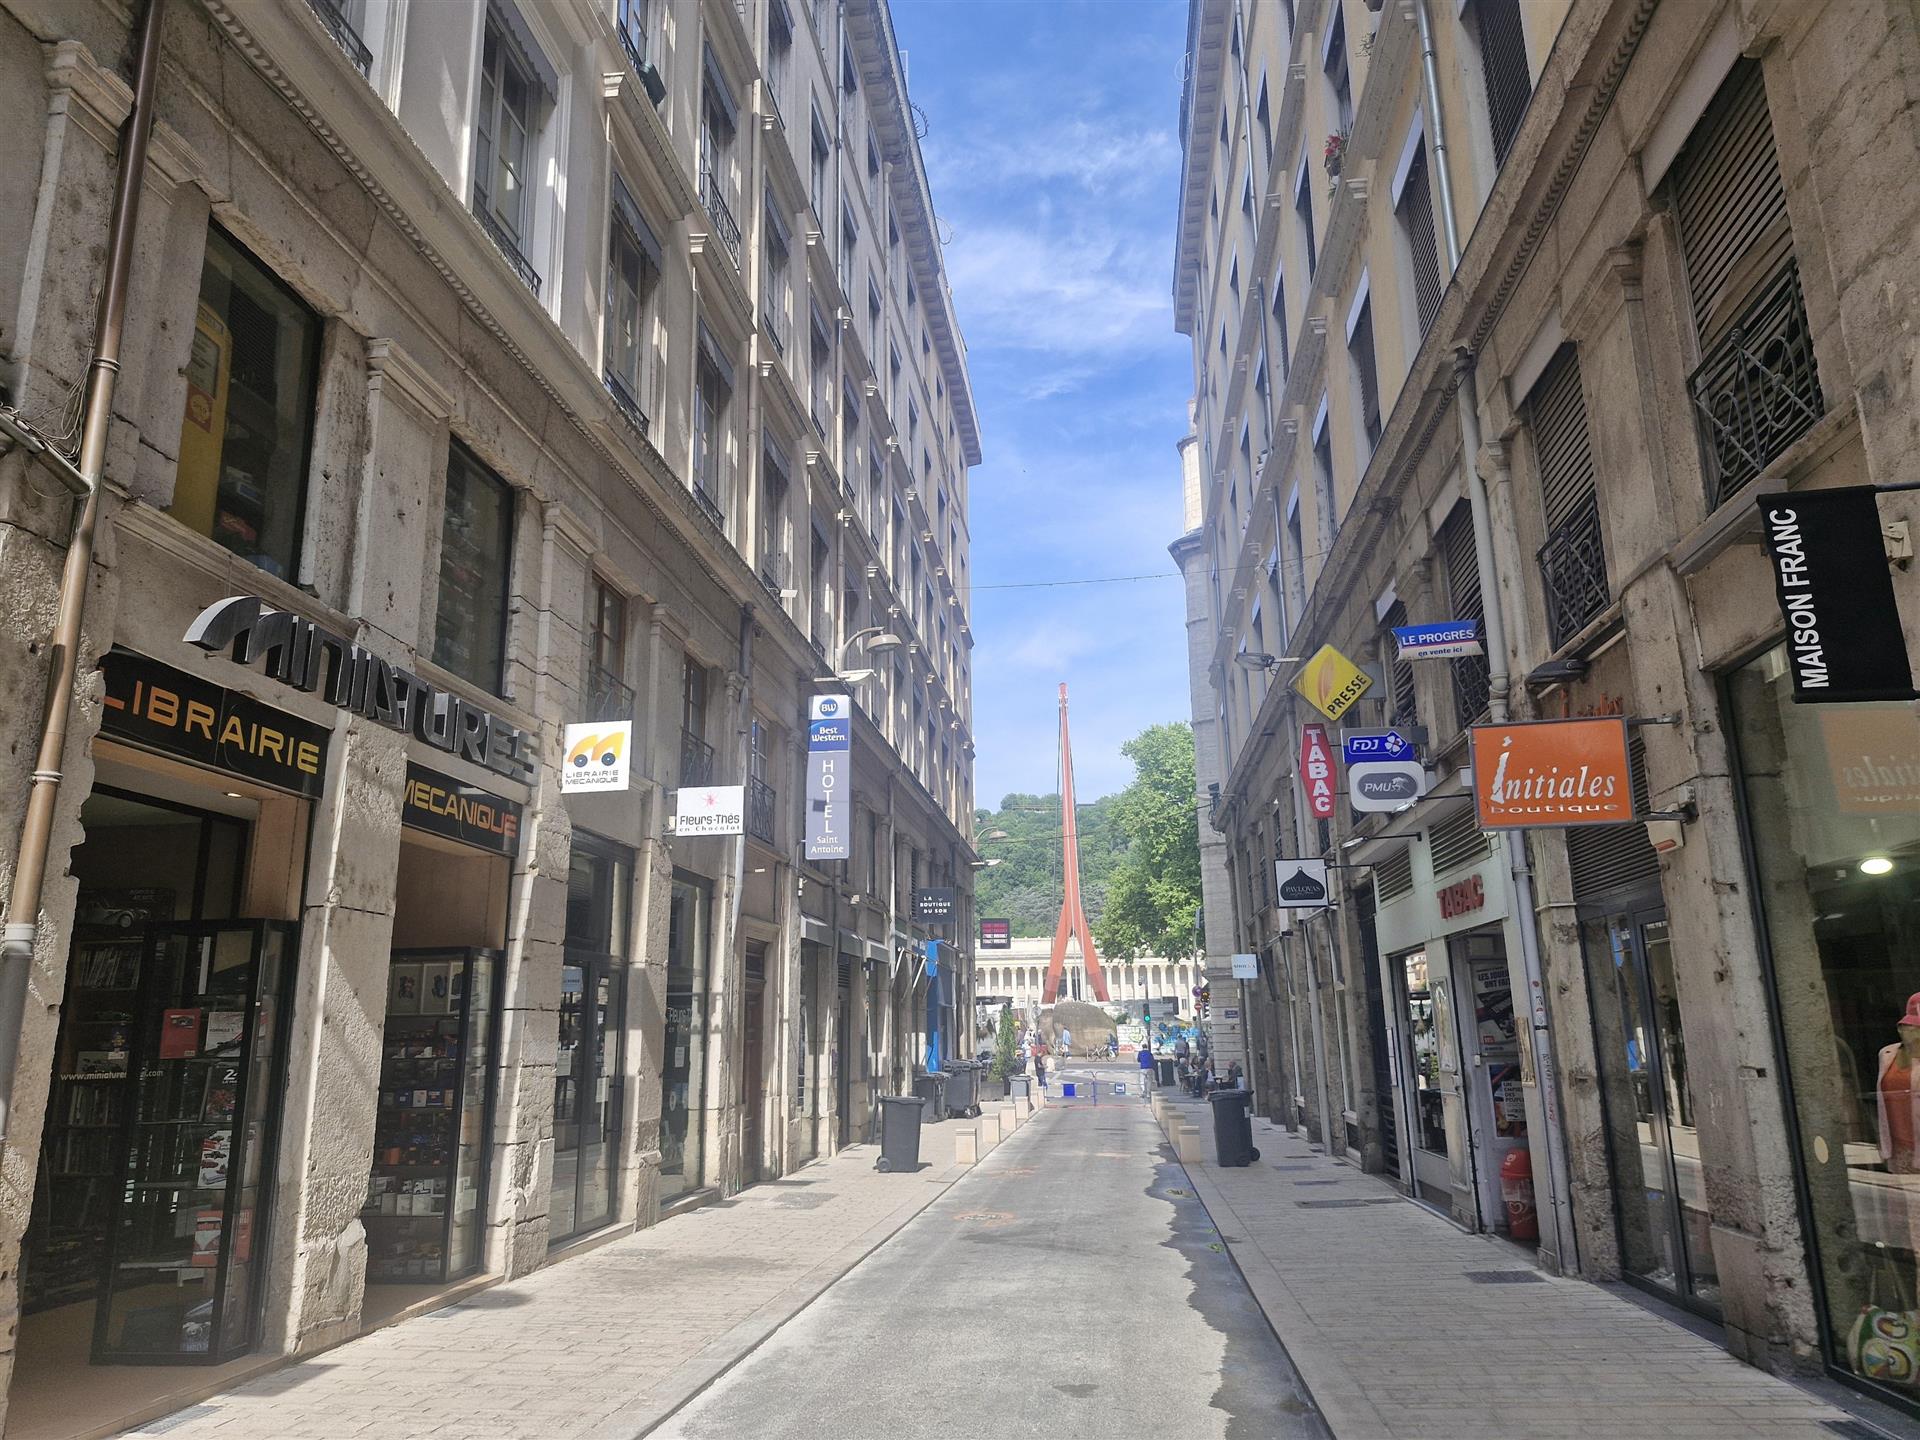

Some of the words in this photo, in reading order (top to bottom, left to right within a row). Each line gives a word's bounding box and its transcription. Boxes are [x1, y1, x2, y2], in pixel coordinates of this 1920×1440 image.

[1769, 508, 1811, 587] FRANC
[1402, 635, 1416, 646] LE
[1785, 593, 1830, 688] MAISON
[1430, 648, 1451, 656] vente
[1327, 674, 1367, 715] PRESSE
[821, 703, 837, 712] BW
[819, 726, 838, 735] Best
[811, 734, 846, 742] Western
[1352, 739, 1379, 751] FDJ
[565, 769, 619, 779] LIBRAIRIE
[1306, 728, 1331, 812] TABAC
[1490, 735, 1616, 804] Initiales
[565, 777, 619, 785] MECANIQUE
[1364, 783, 1392, 792] PMU
[822, 759, 835, 833] HOTEL
[1491, 804, 1618, 814] boutique
[816, 835, 838, 844] Saint
[811, 845, 844, 854] Antoine
[1436, 874, 1485, 919] TABAC
